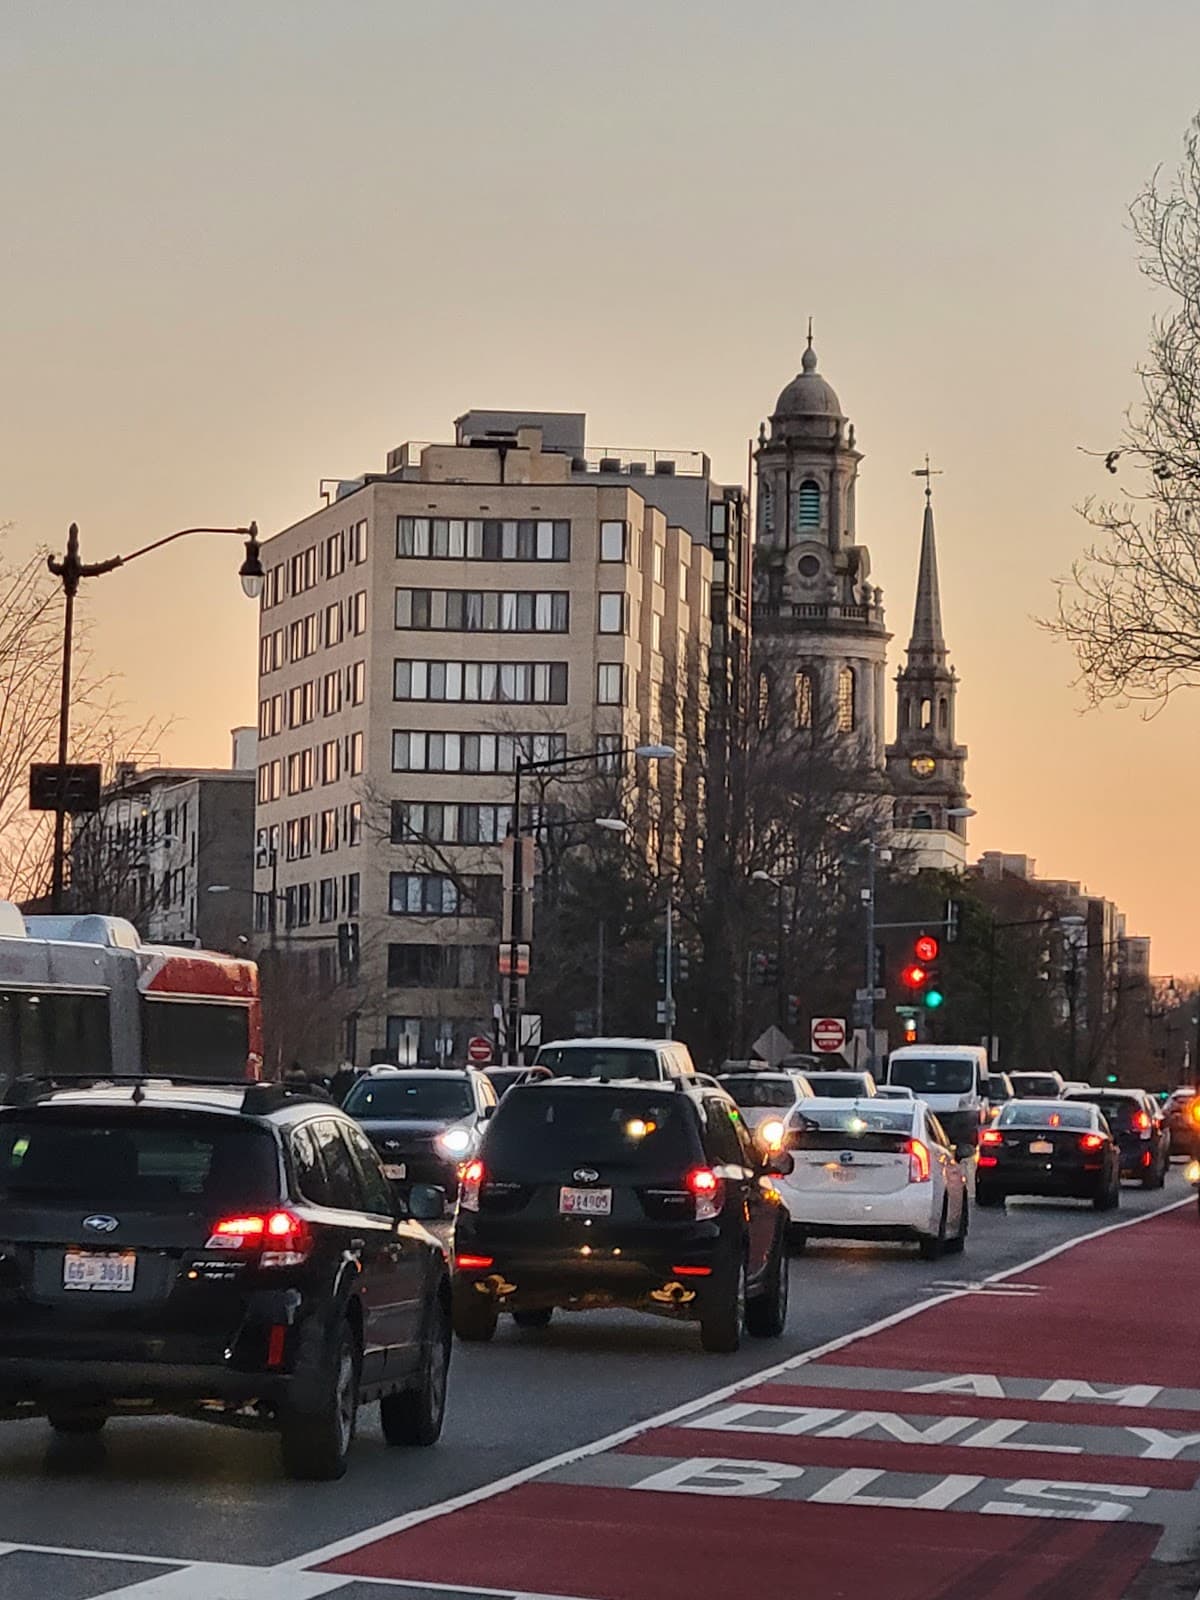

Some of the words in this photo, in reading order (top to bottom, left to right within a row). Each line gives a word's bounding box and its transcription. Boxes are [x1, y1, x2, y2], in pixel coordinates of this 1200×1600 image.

[902, 1373, 1165, 1408] AM
[679, 1402, 1200, 1459] ONLY
[629, 1457, 1152, 1522] BUS
